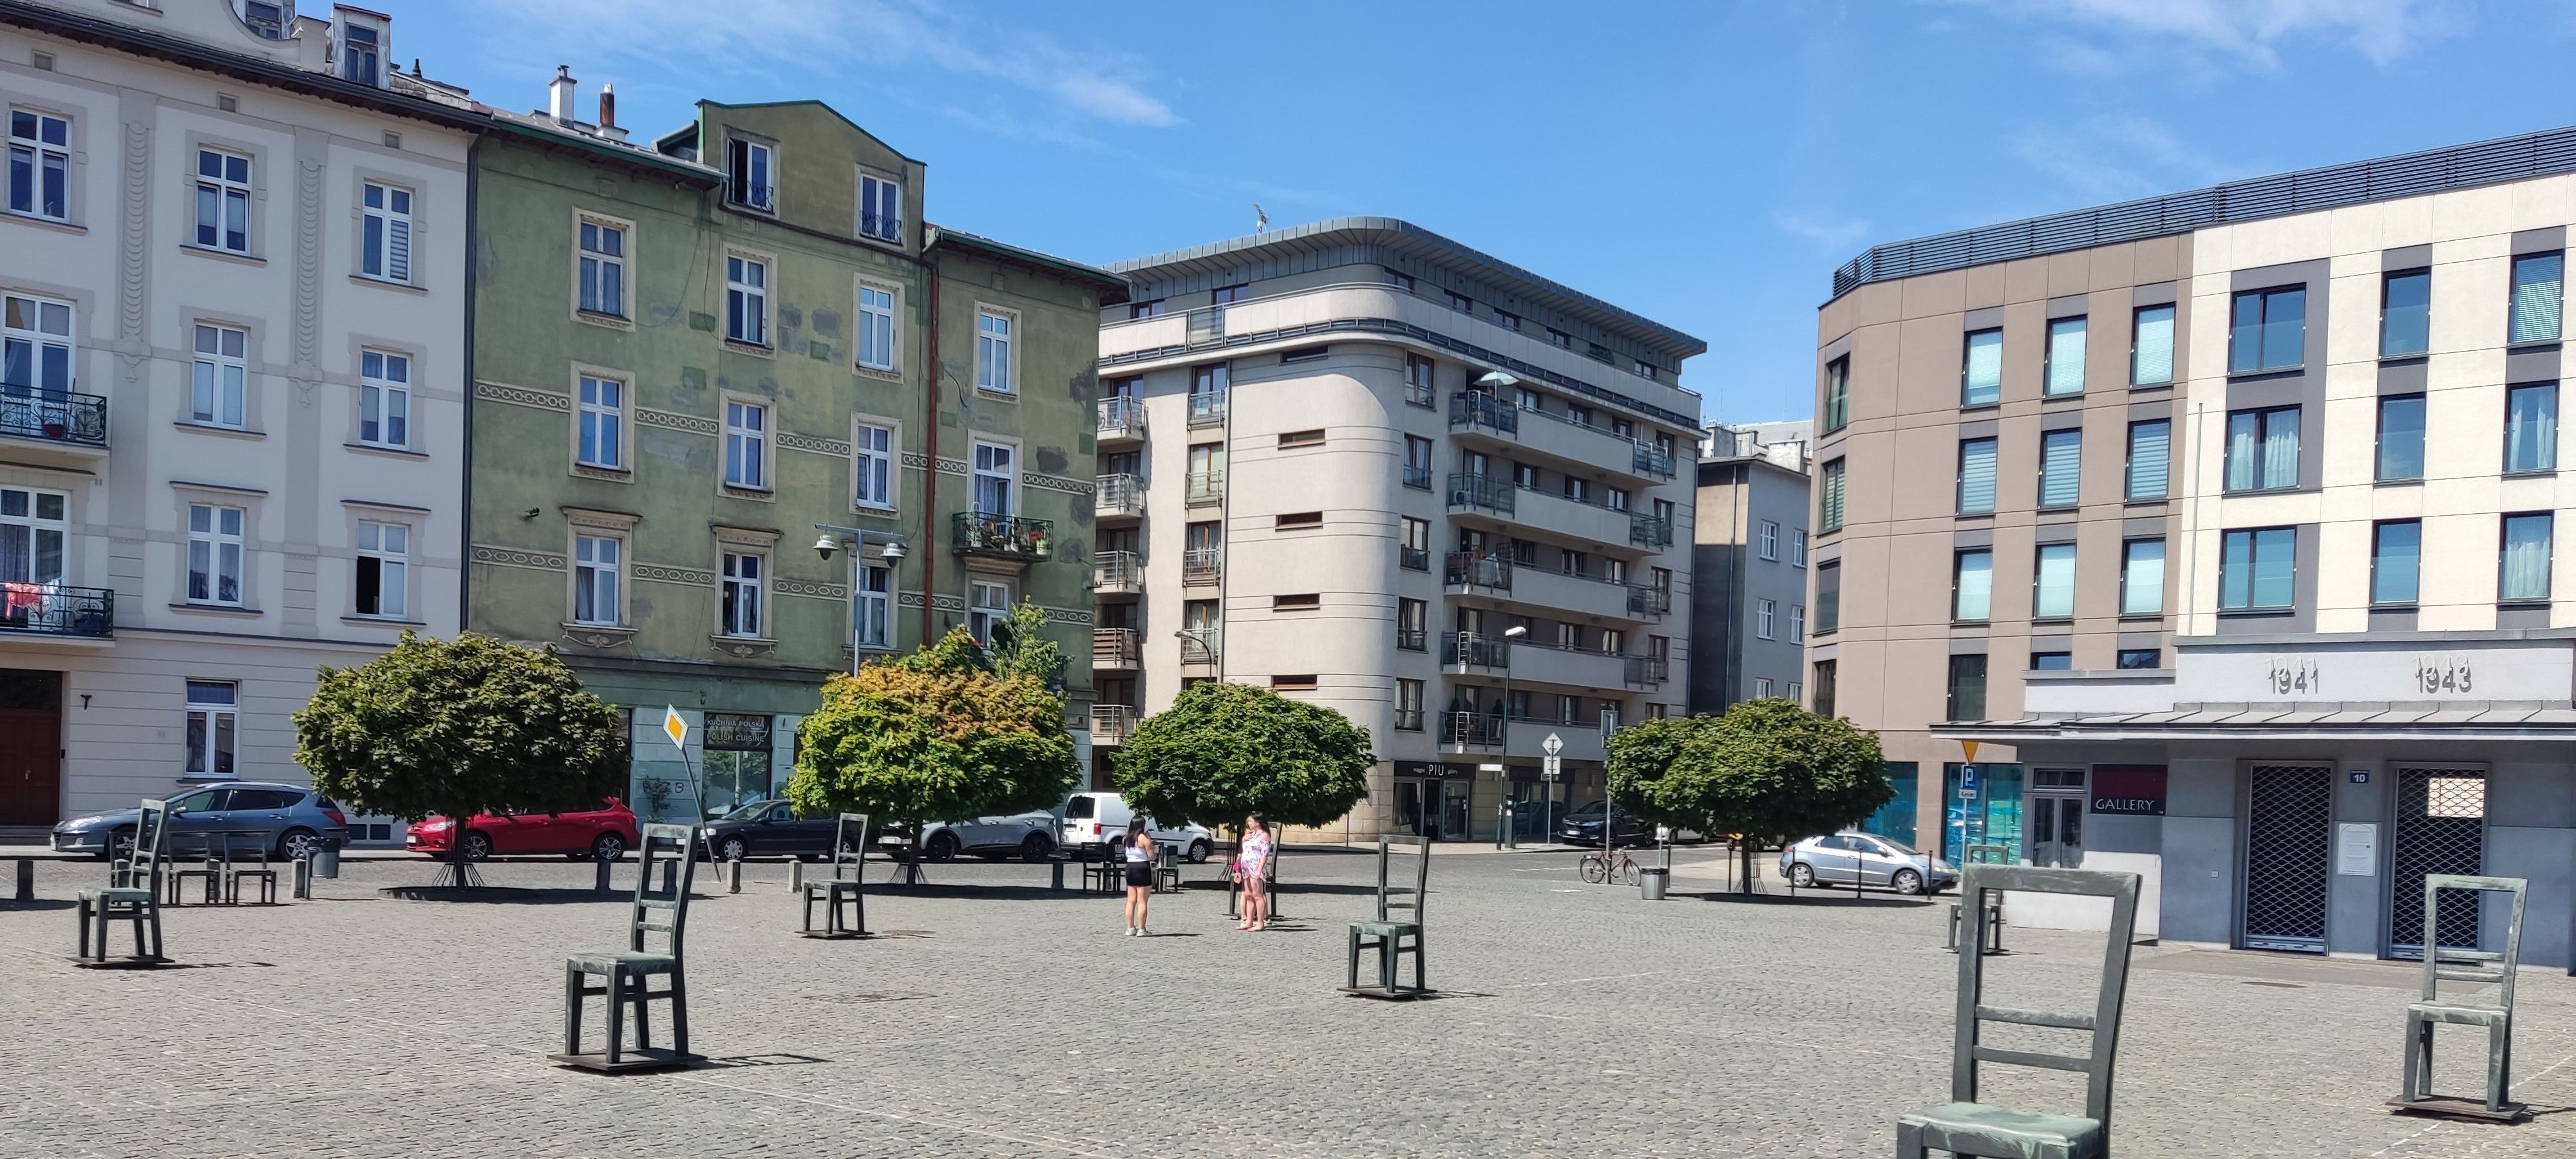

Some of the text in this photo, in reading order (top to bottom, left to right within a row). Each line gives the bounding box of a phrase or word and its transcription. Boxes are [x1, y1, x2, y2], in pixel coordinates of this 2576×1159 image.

[2263, 654, 2472, 694] 1941 1943
[1429, 764, 1444, 776] PIU
[1965, 768, 1974, 786] P
[2354, 774, 2365, 782] 10
[2096, 798, 2155, 811] GALLERY
